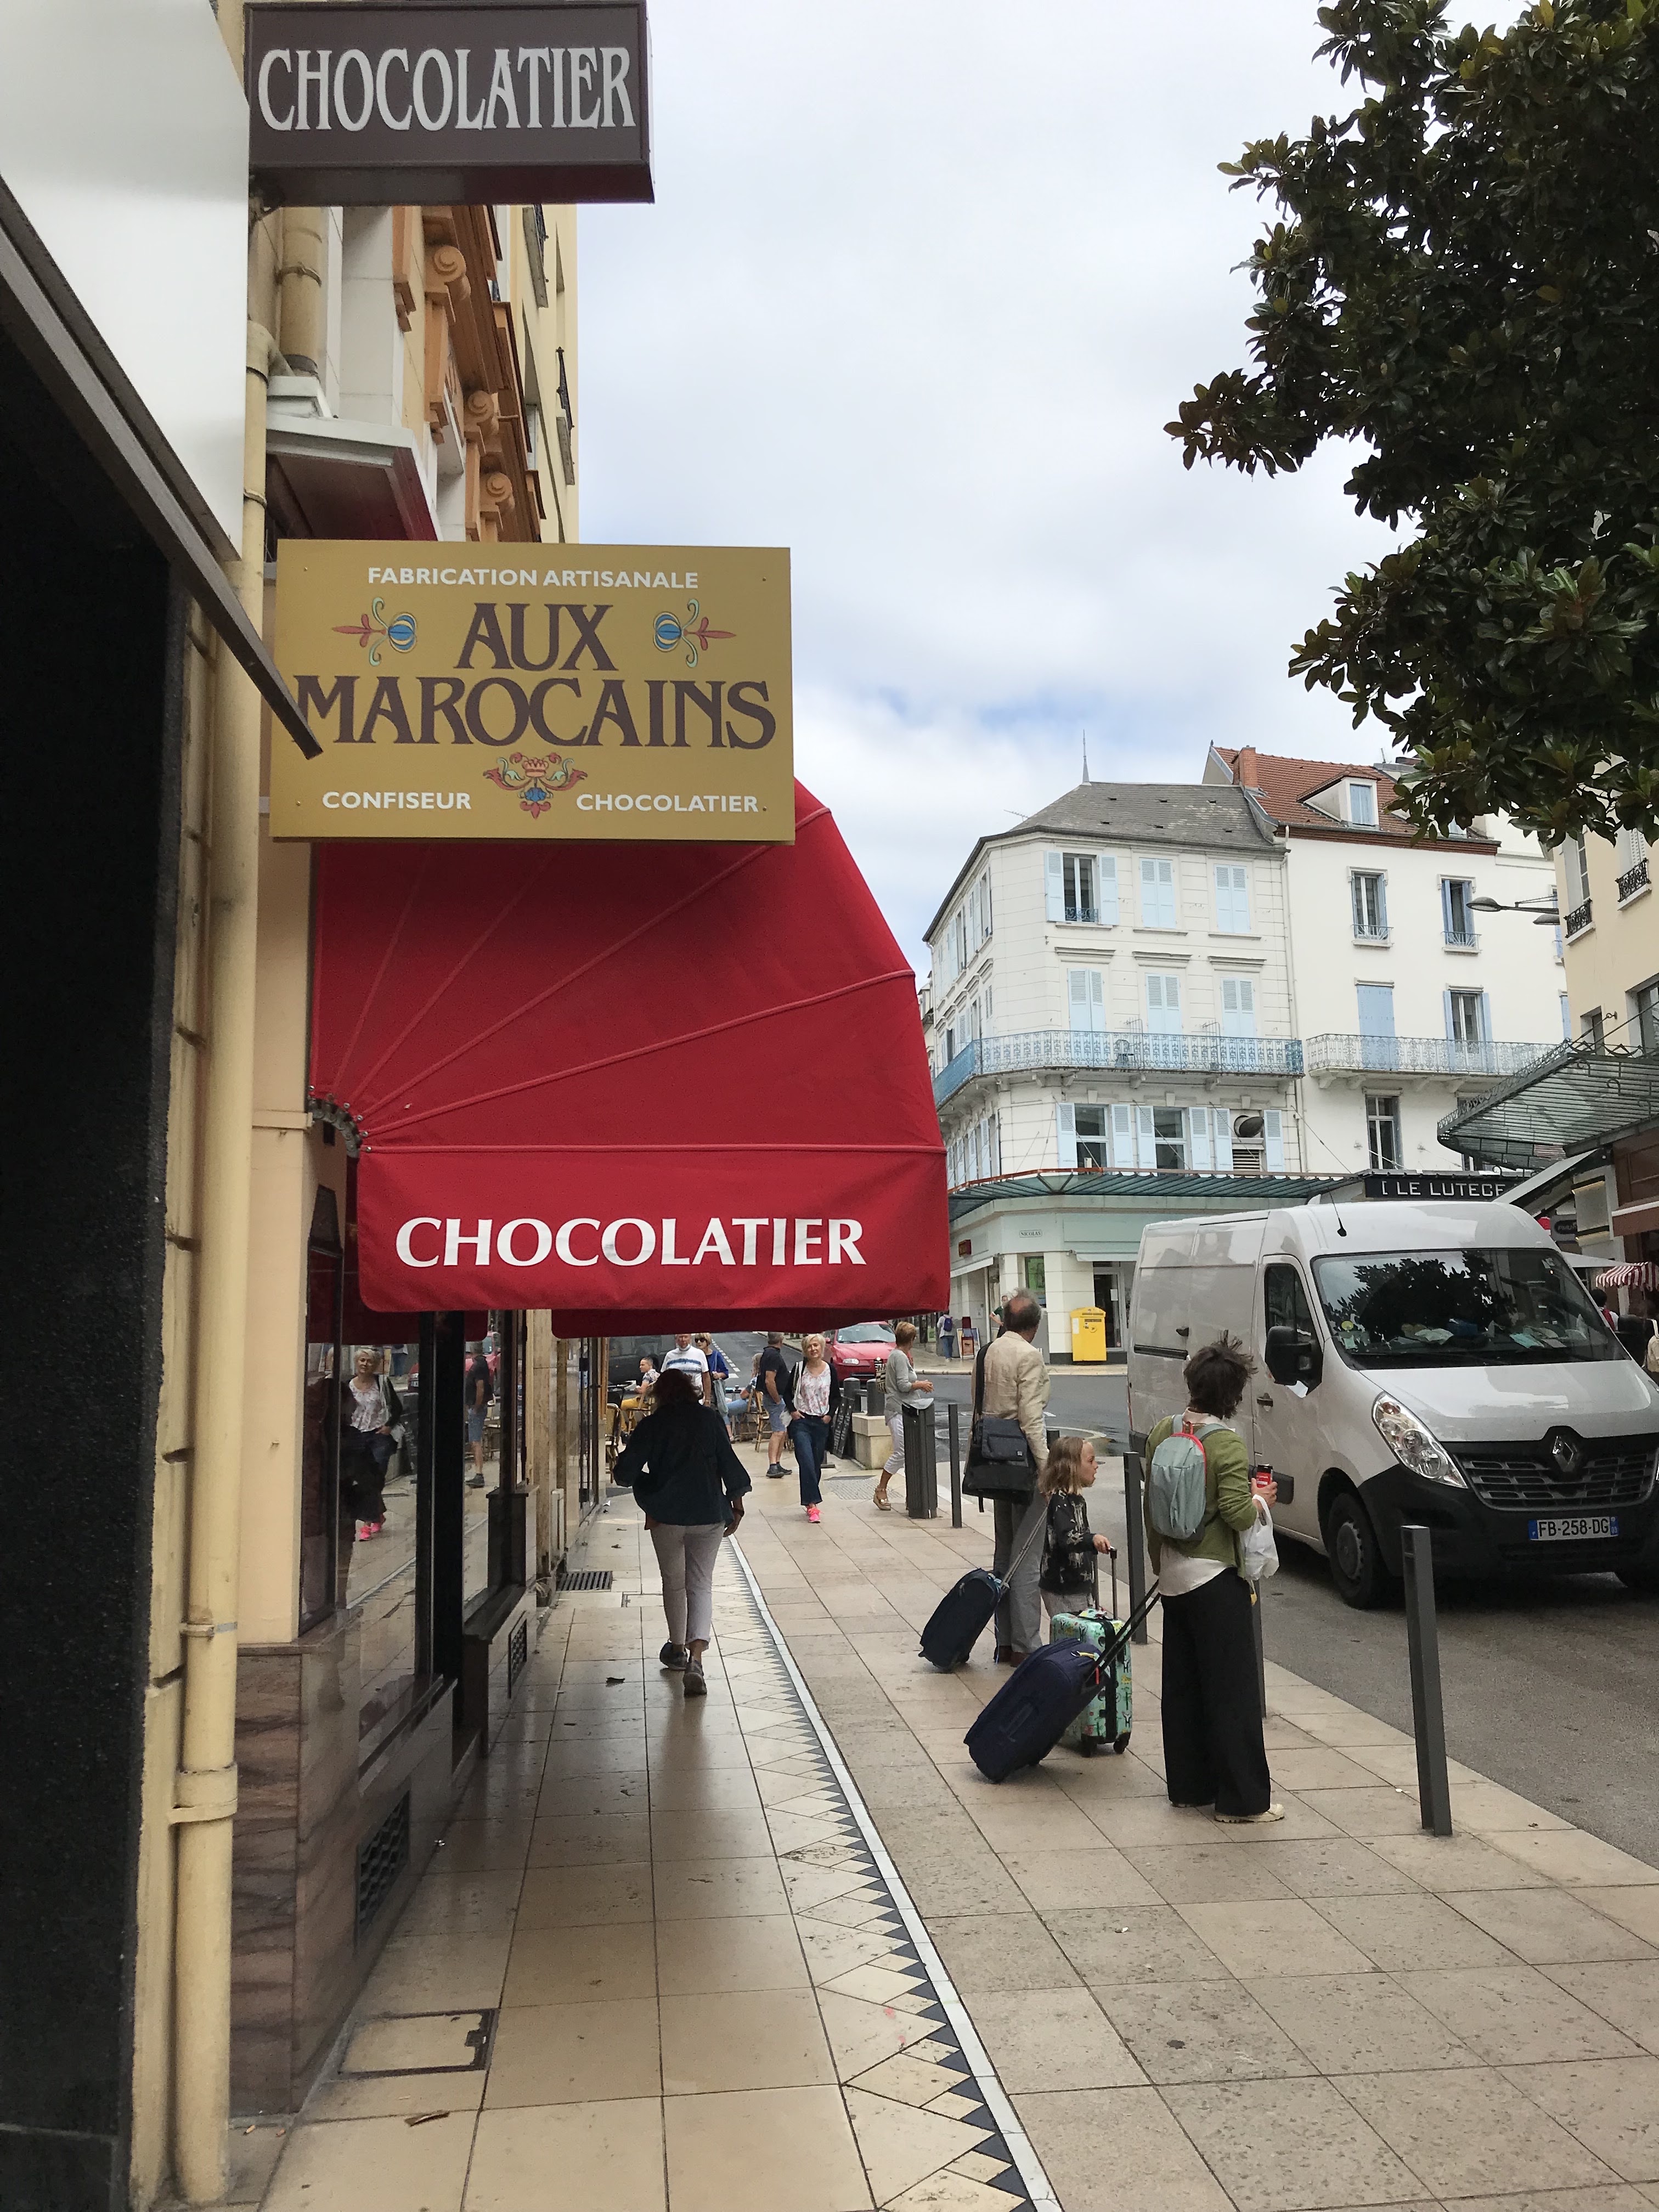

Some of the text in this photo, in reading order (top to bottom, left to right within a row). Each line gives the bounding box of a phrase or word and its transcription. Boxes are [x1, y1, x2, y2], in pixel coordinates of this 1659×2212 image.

[258, 47, 636, 132] CHOCOLATIER
[368, 567, 698, 589] FABRICATION ARTISANALE
[453, 602, 619, 672] AUX
[292, 675, 776, 750] MAROCAINS
[322, 791, 472, 810] CONFISEUR
[576, 793, 759, 812] CHOCOLATIER
[1397, 1181, 1421, 1195] LE
[395, 1216, 867, 1268] CHOCOLATIER
[1538, 1518, 1609, 1537] FB-258-DG
